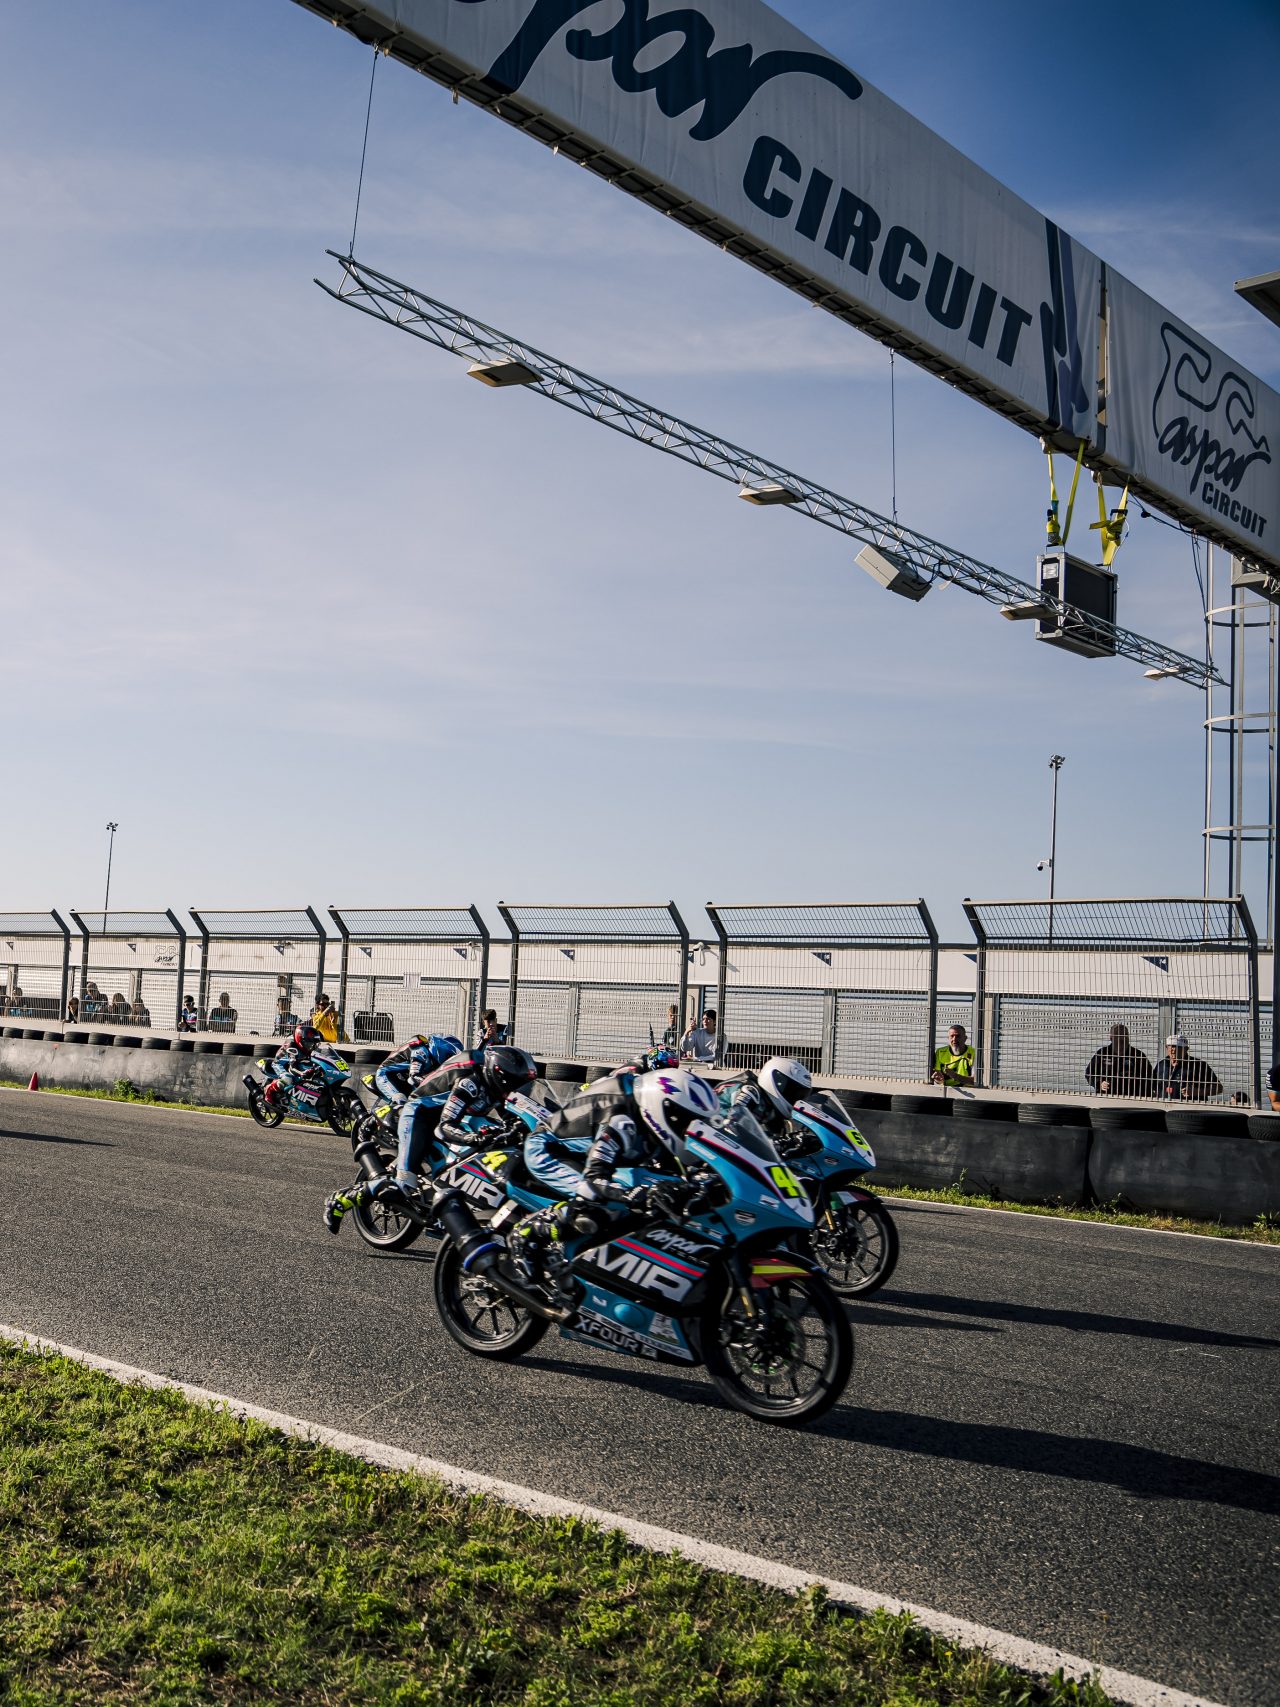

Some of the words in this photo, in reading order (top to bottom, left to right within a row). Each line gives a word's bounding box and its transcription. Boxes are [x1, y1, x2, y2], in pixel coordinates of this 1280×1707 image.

[478, 0, 864, 141] par
[742, 135, 1033, 367] CIRCUIT
[1158, 416, 1272, 495] aspar
[1202, 482, 1268, 538] CIRCUIT
[287, 1087, 319, 1106] MIR
[440, 1168, 506, 1208] MIR
[645, 1228, 721, 1255] aspar
[581, 1244, 694, 1303] MIR
[574, 1315, 640, 1352] XFOUR
